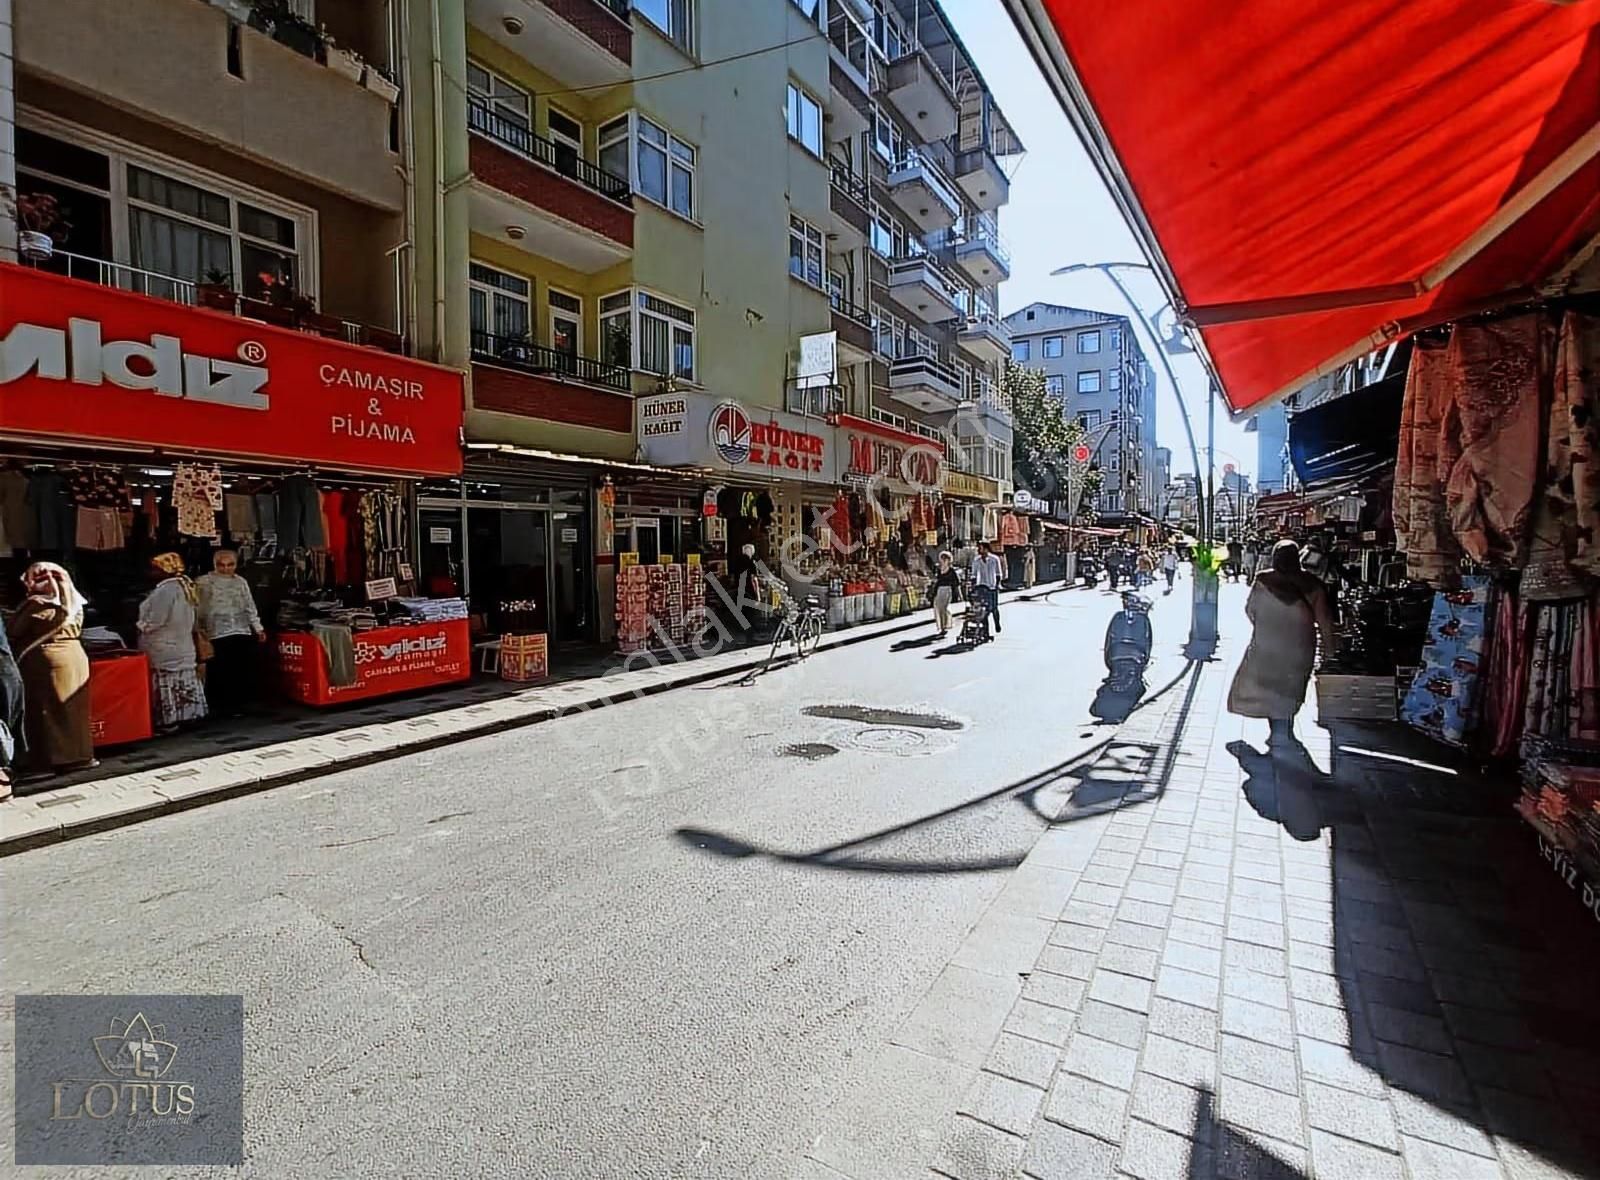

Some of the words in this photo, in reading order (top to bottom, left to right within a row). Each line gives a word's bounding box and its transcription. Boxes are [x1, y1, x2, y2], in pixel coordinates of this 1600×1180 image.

[319, 364, 424, 400] ÇAMAŞIR
[367, 397, 382, 415] &
[643, 400, 685, 417] HÜNER
[331, 414, 416, 444] PİJAMA
[644, 418, 682, 436] KAĞIT
[749, 419, 824, 456] HÜNER
[378, 635, 447, 660] yıldız
